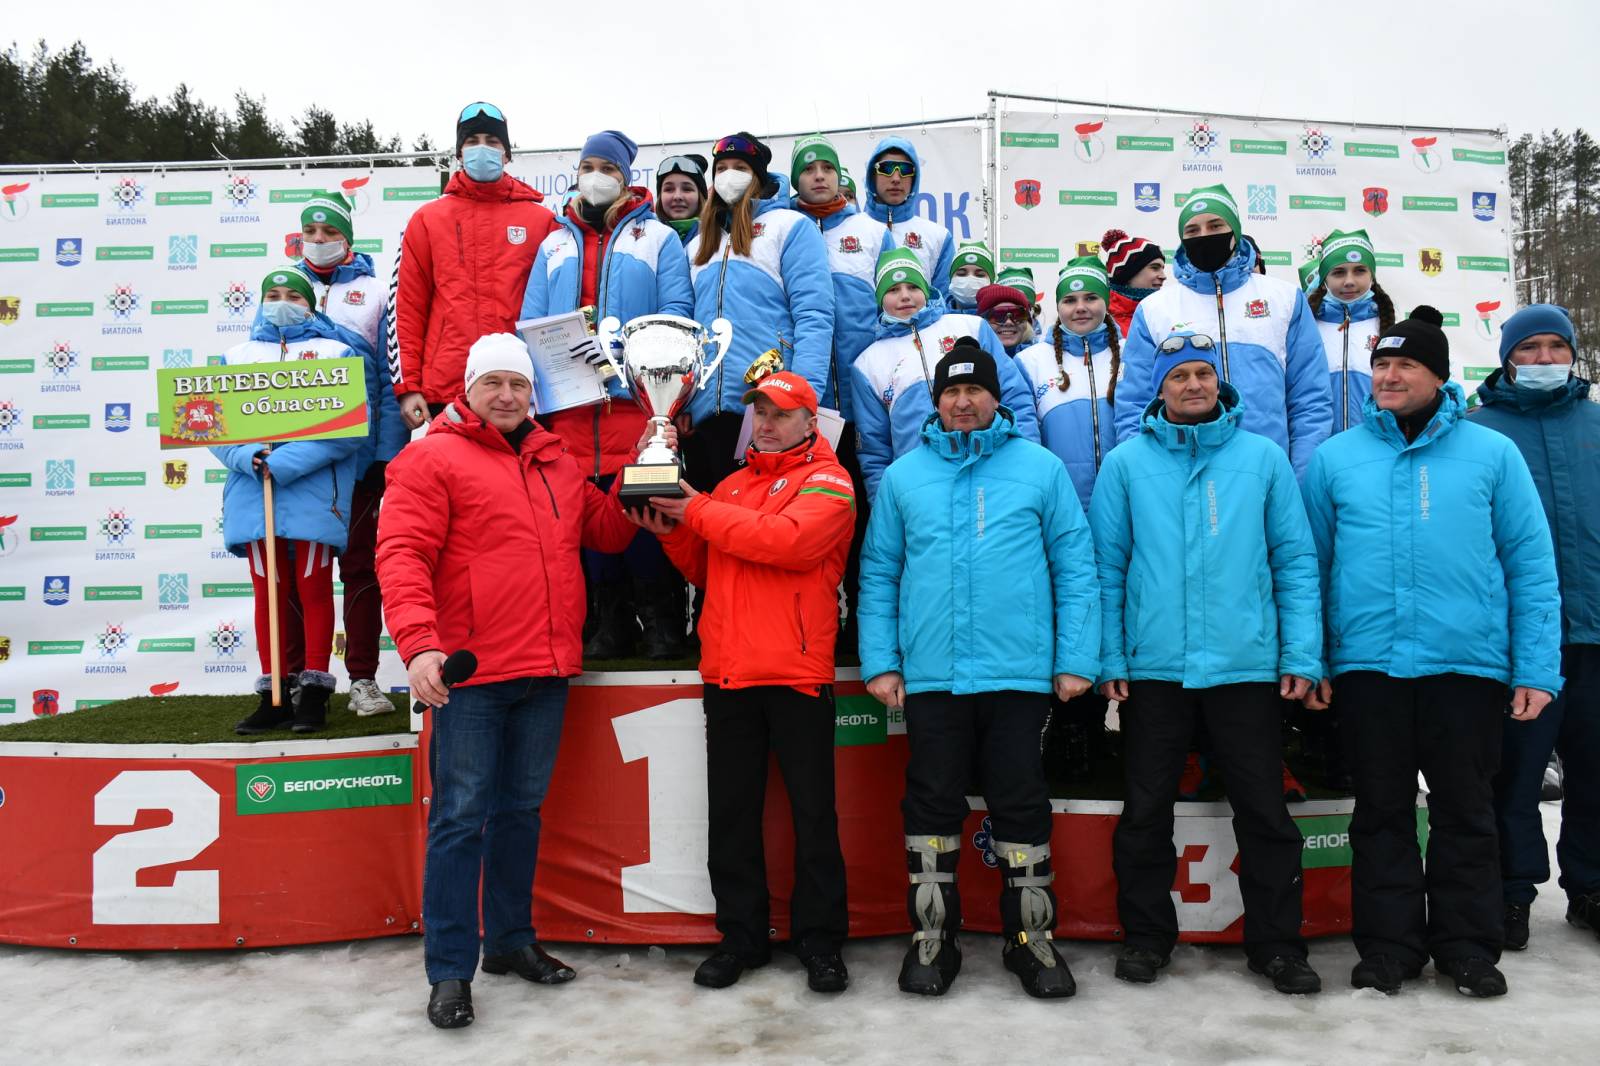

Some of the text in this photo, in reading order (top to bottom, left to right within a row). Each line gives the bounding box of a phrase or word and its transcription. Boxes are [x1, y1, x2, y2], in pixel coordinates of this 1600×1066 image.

[1182, 163, 1223, 173] БИАТЛОНА
[1296, 167, 1337, 176] БИАТЛОНА
[106, 217, 147, 226] БИАТЛОНА
[220, 215, 260, 224] БИАТЛОНА
[102, 326, 143, 335] БИАТЛОНА
[216, 324, 252, 332] БИАТЛОН
[174, 367, 350, 395] ВИТЕБСКАЯ
[41, 384, 81, 393] БИАТЛОНА
[241, 396, 345, 415] область
[0, 442, 24, 450] ТЛОНА
[1419, 464, 1430, 520] NORDSKI
[95, 552, 136, 561] БИАТЛОНА
[211, 551, 237, 559] БИАТЛ
[85, 665, 127, 674] БИАТЛОНА
[204, 664, 247, 674] БИАТЛОНА
[284, 774, 403, 793] БЕЛОРУСНЕФТЬ
[610, 698, 716, 915] 1
[93, 770, 220, 924] 2
[1170, 815, 1245, 932] 3
